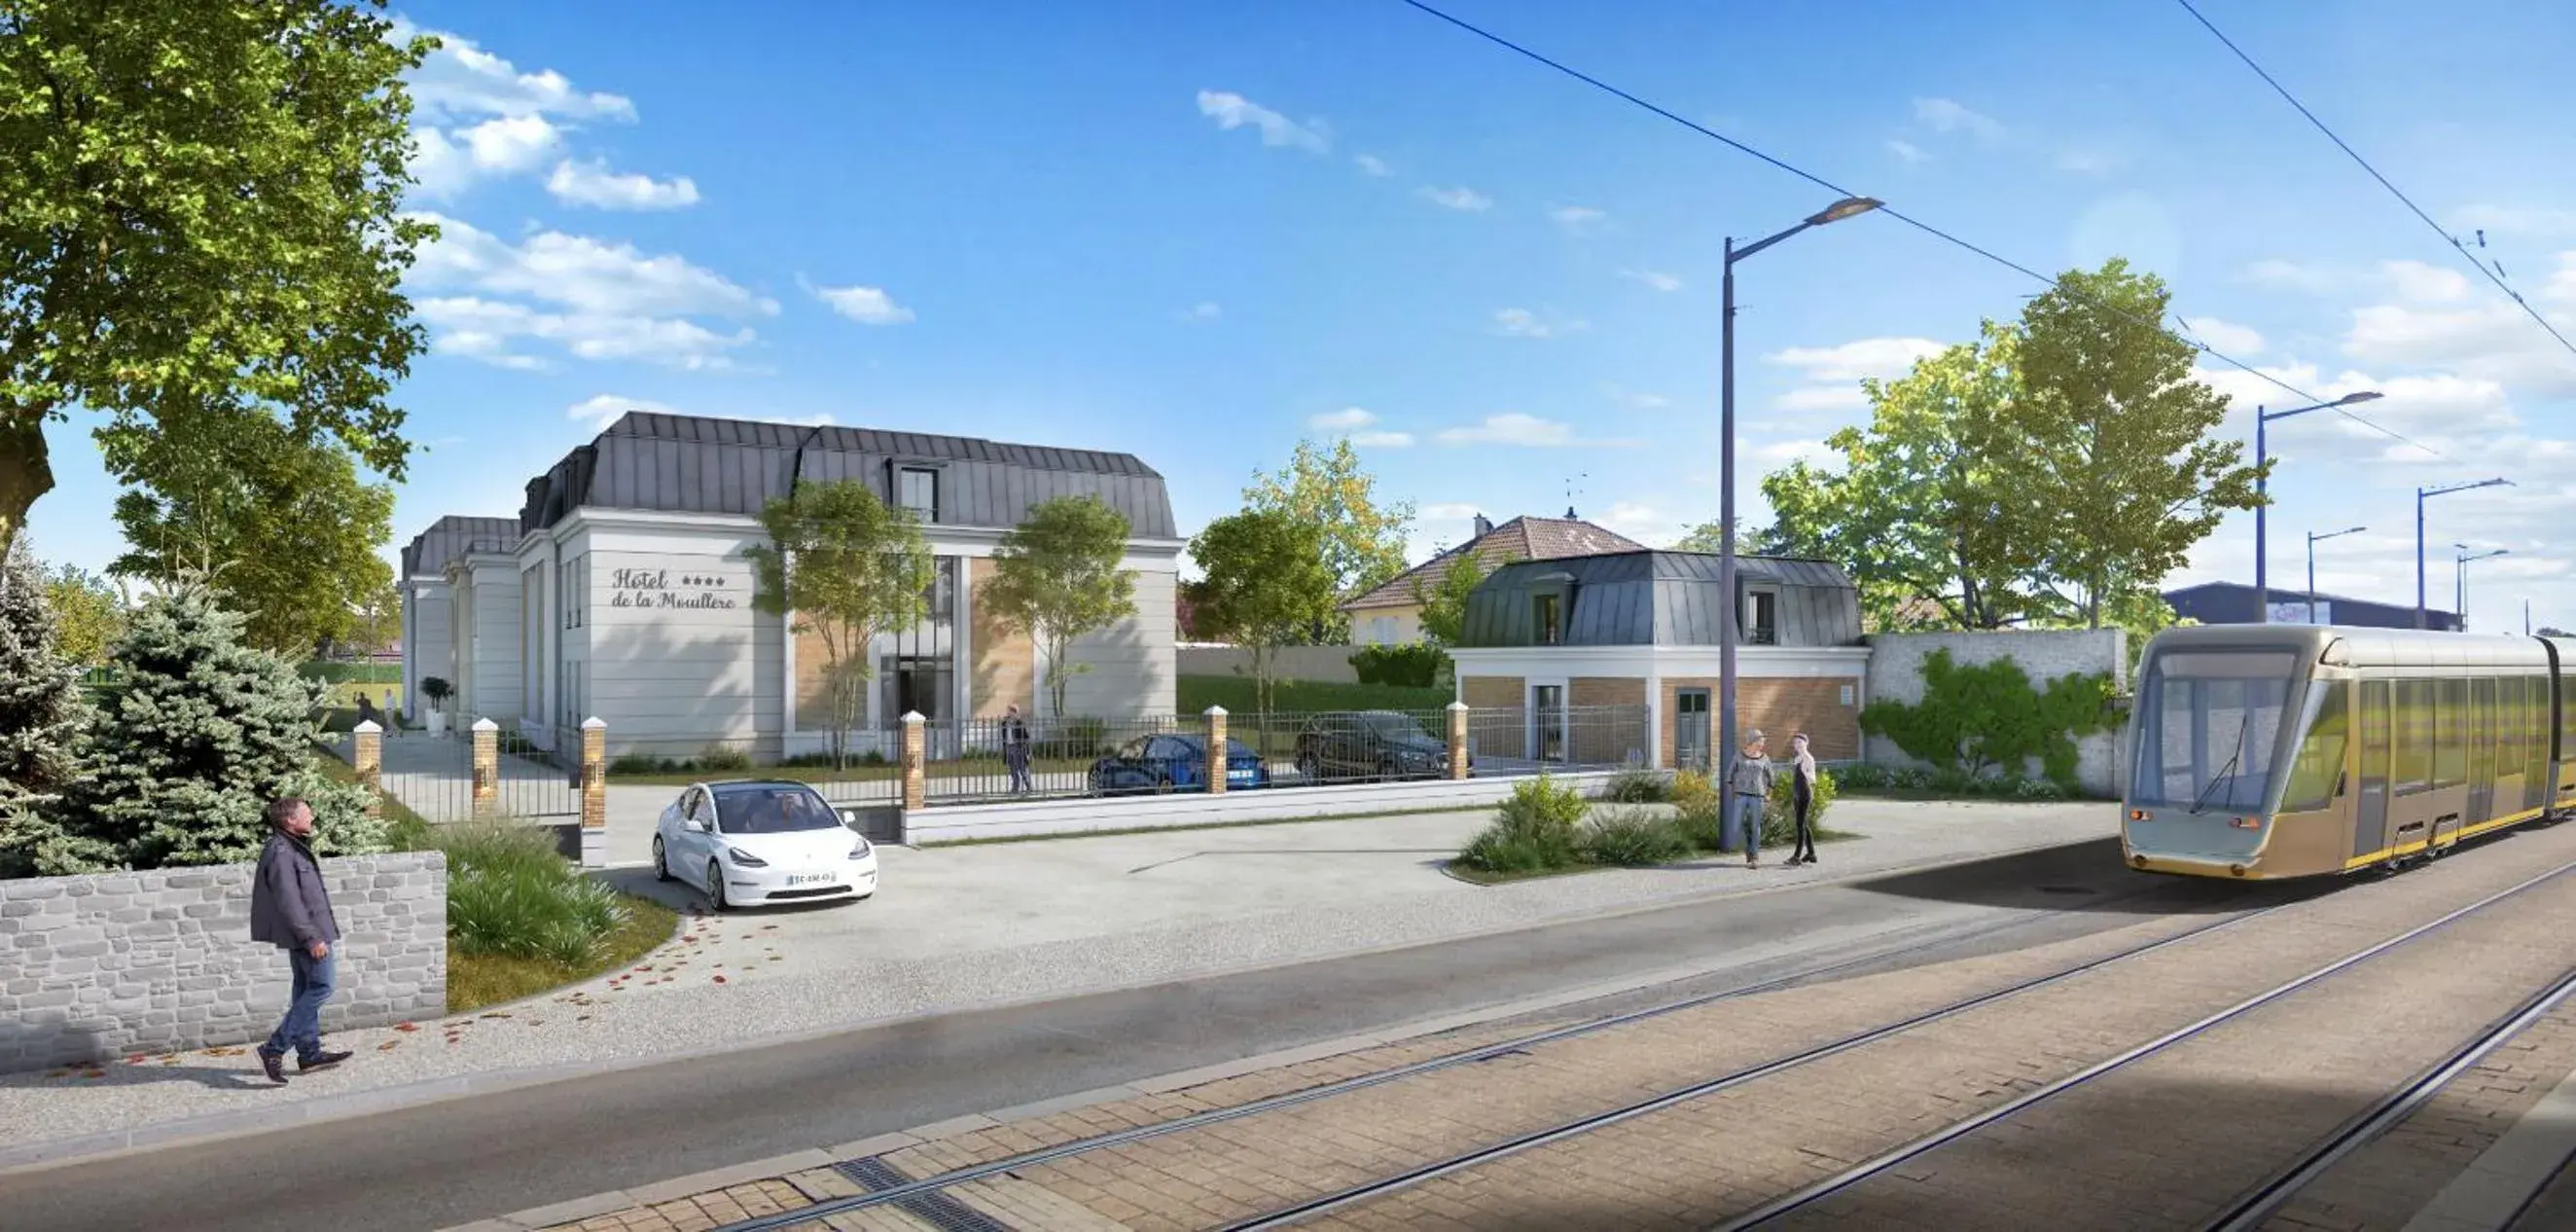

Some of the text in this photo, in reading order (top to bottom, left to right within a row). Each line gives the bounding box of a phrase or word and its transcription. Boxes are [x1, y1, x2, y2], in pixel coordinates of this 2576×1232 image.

[612, 568, 668, 589] Hotel
[611, 591, 632, 607] de
[635, 591, 653, 607] la
